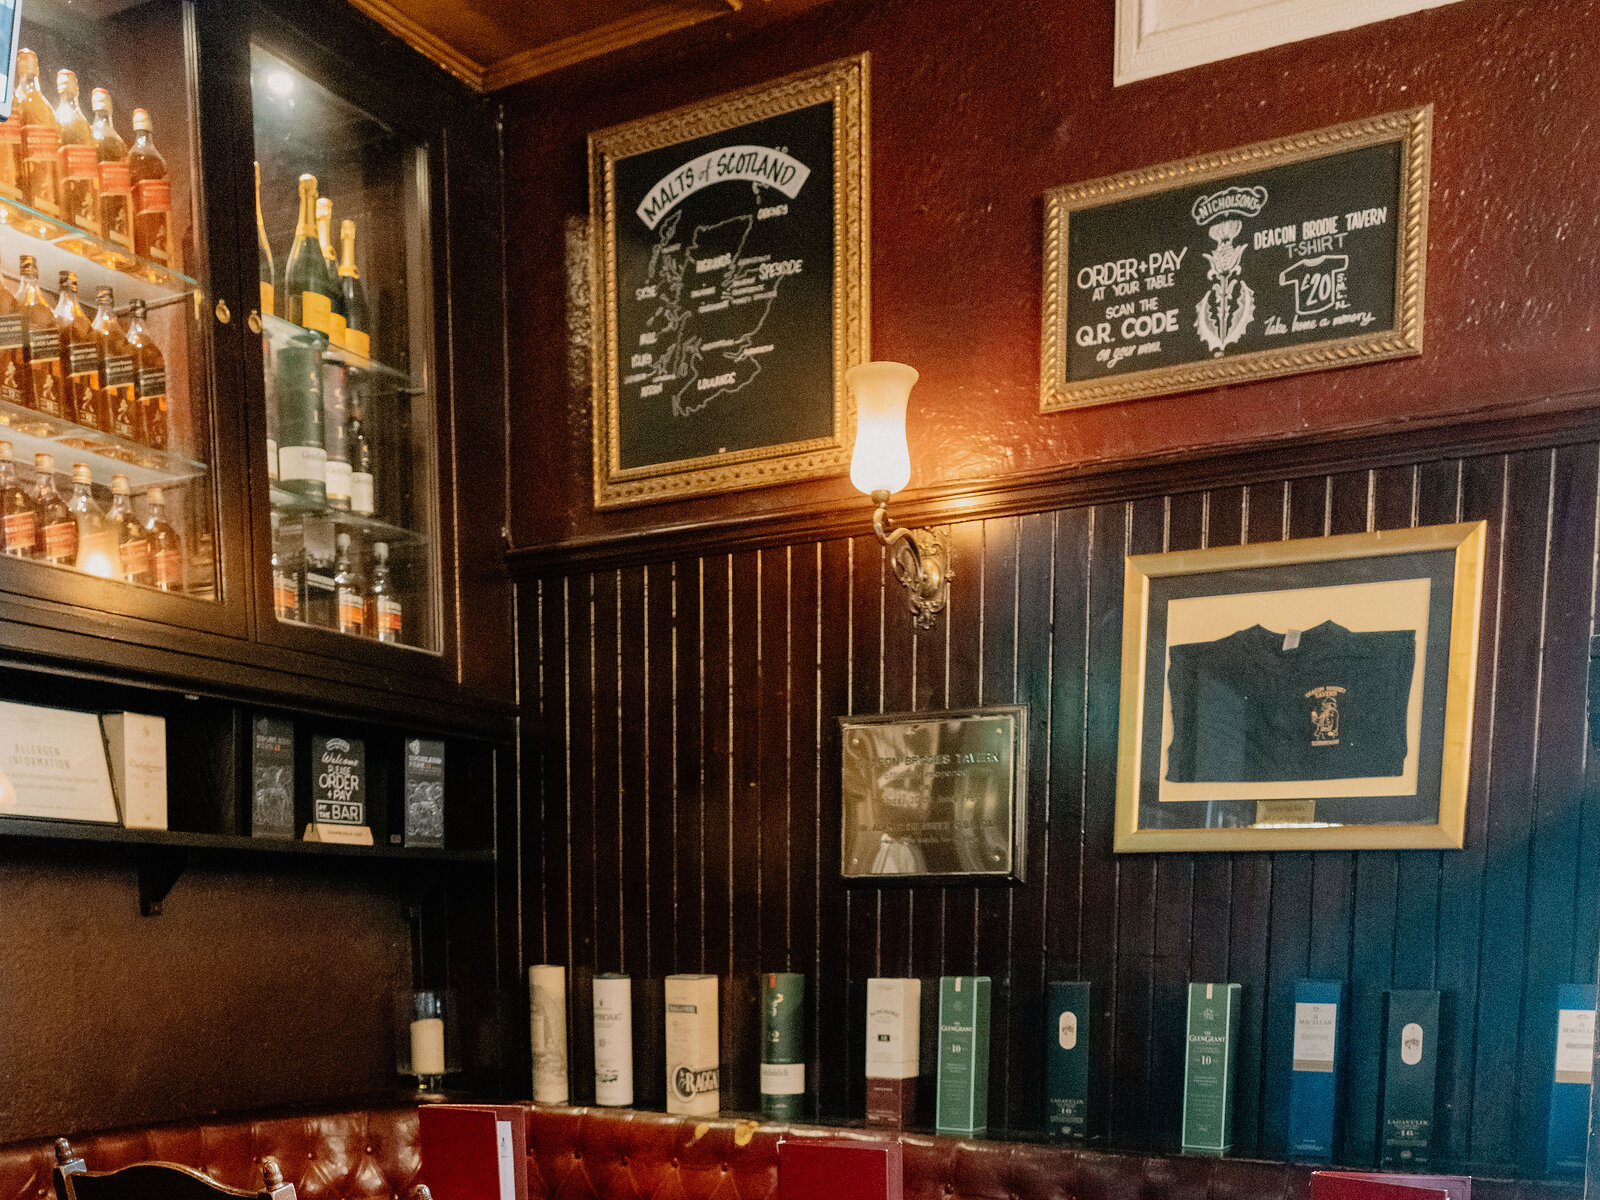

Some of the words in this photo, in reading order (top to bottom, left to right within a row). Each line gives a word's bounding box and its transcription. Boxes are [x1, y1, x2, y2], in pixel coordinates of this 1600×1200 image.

[643, 167, 694, 222] MALTS
[698, 158, 712, 182] of
[717, 152, 796, 186] SCOTLAND
[1253, 224, 1296, 250] DEACON
[1302, 215, 1339, 240] BRODIE
[1345, 206, 1387, 232] TAVERN
[1092, 286, 1106, 302] AT
[1112, 281, 1140, 296] YOUR
[1144, 272, 1175, 291] TABLE
[1105, 302, 1135, 319] SCAN
[1139, 297, 1158, 312] THE
[1121, 308, 1179, 339] CODE
[1319, 317, 1331, 327] a
[15, 743, 61, 757] ALLERGEN
[9, 755, 70, 770] INFORMATION
[322, 752, 358, 767] Welcome
[319, 773, 359, 790] ORDER
[332, 804, 358, 820] BAR
[1201, 1055, 1212, 1065] 10
